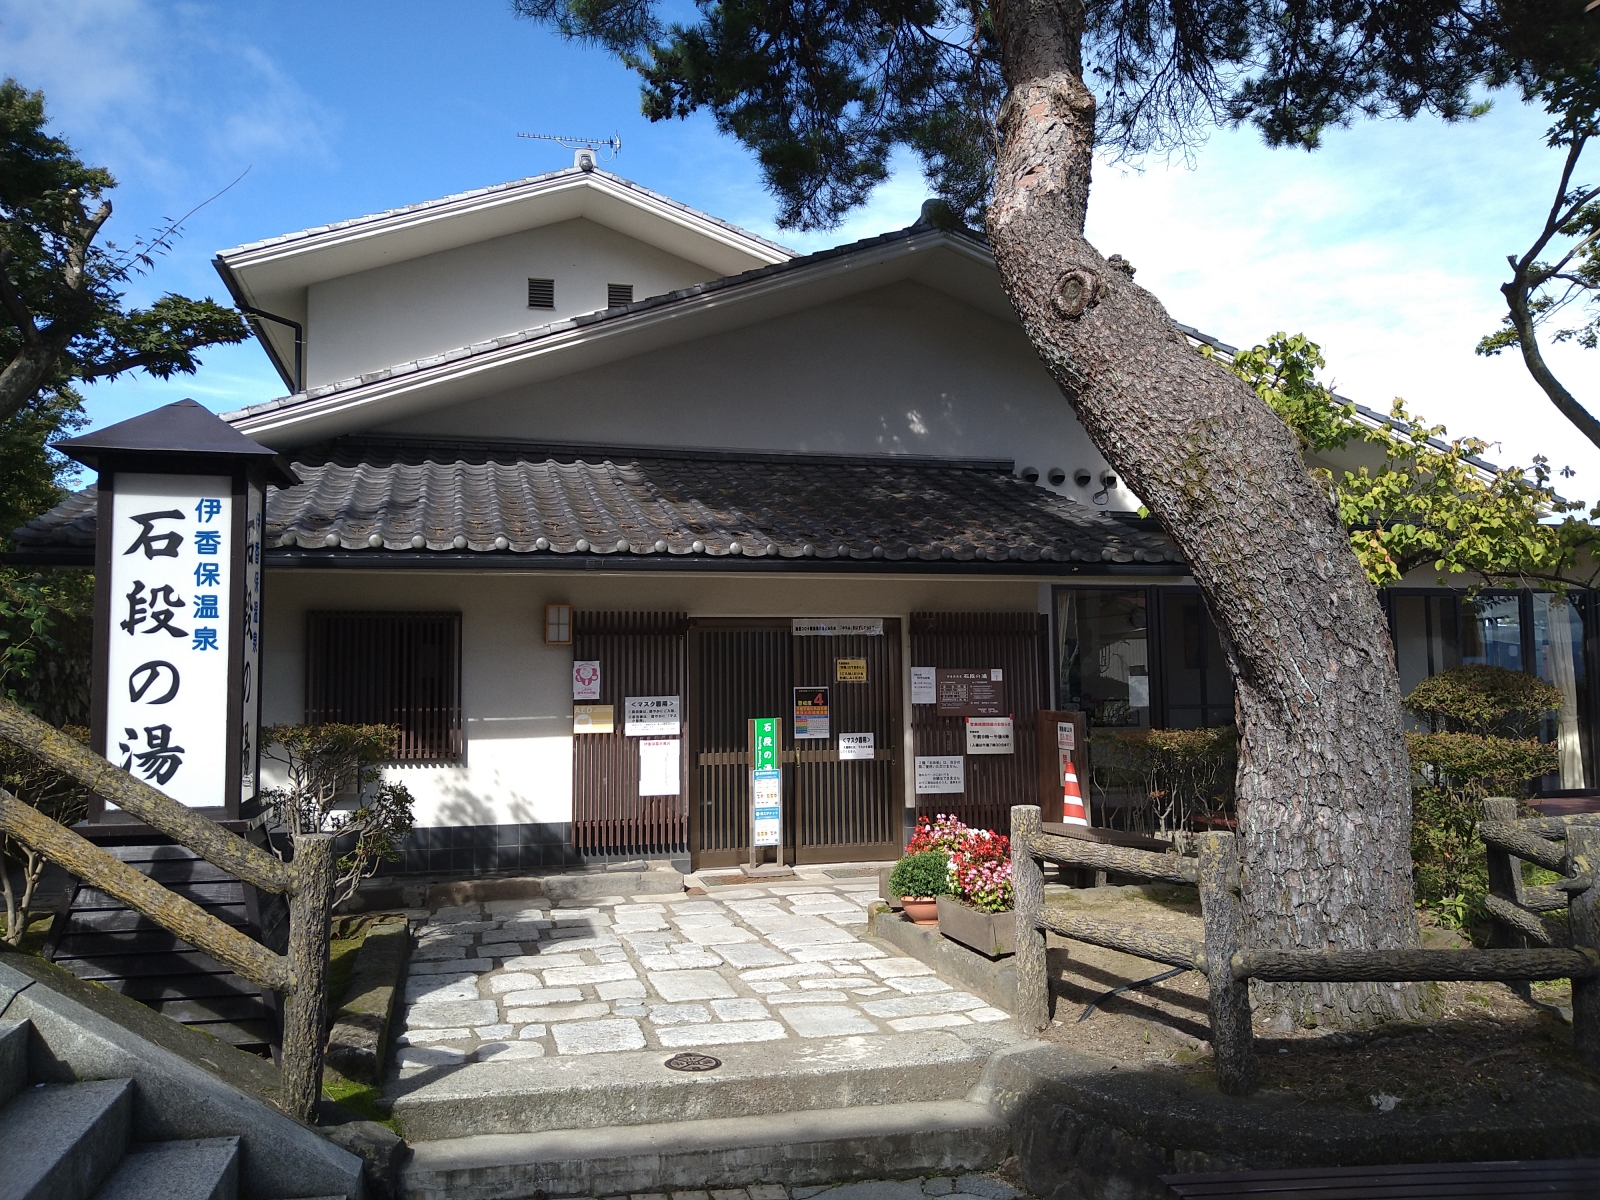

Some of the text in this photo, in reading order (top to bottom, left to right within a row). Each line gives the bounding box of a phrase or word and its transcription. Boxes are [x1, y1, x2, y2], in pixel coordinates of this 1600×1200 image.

[119, 508, 189, 786] 石段の湯
[192, 498, 222, 652] 伊香保温泉
[814, 693, 824, 706] 4
